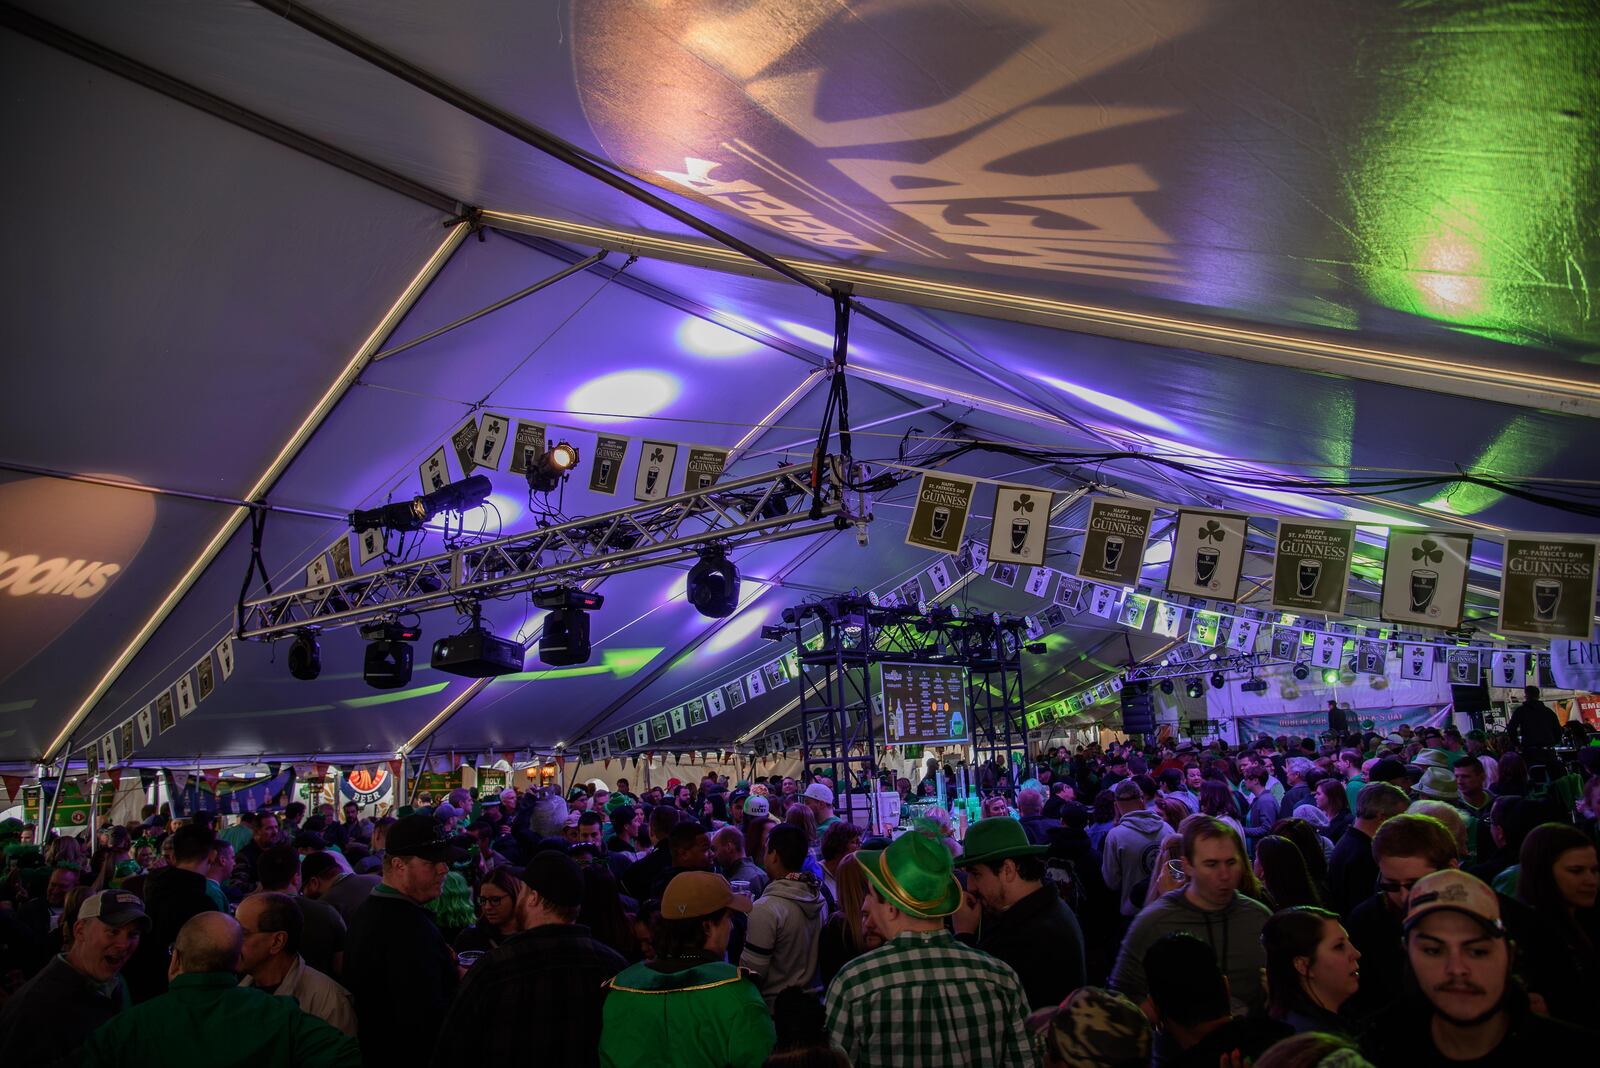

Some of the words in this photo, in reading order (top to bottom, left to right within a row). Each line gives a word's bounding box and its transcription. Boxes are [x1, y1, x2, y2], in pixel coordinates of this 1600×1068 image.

[689, 461, 723, 473] GUINNESS
[922, 489, 967, 507] GUINNESS
[1107, 512, 1130, 520] PATRICK'S
[1092, 517, 1145, 536] GUINNESS
[1298, 533, 1328, 541] PATRICK'S
[1280, 539, 1346, 558] GUINNESS
[1530, 550, 1566, 558] PATRICK'S
[1568, 551, 1584, 559] DAY
[1509, 557, 1590, 576] GUINNESS
[0, 550, 121, 599] OOMS
[484, 777, 501, 785] HOLY
[352, 791, 381, 803] BEER
